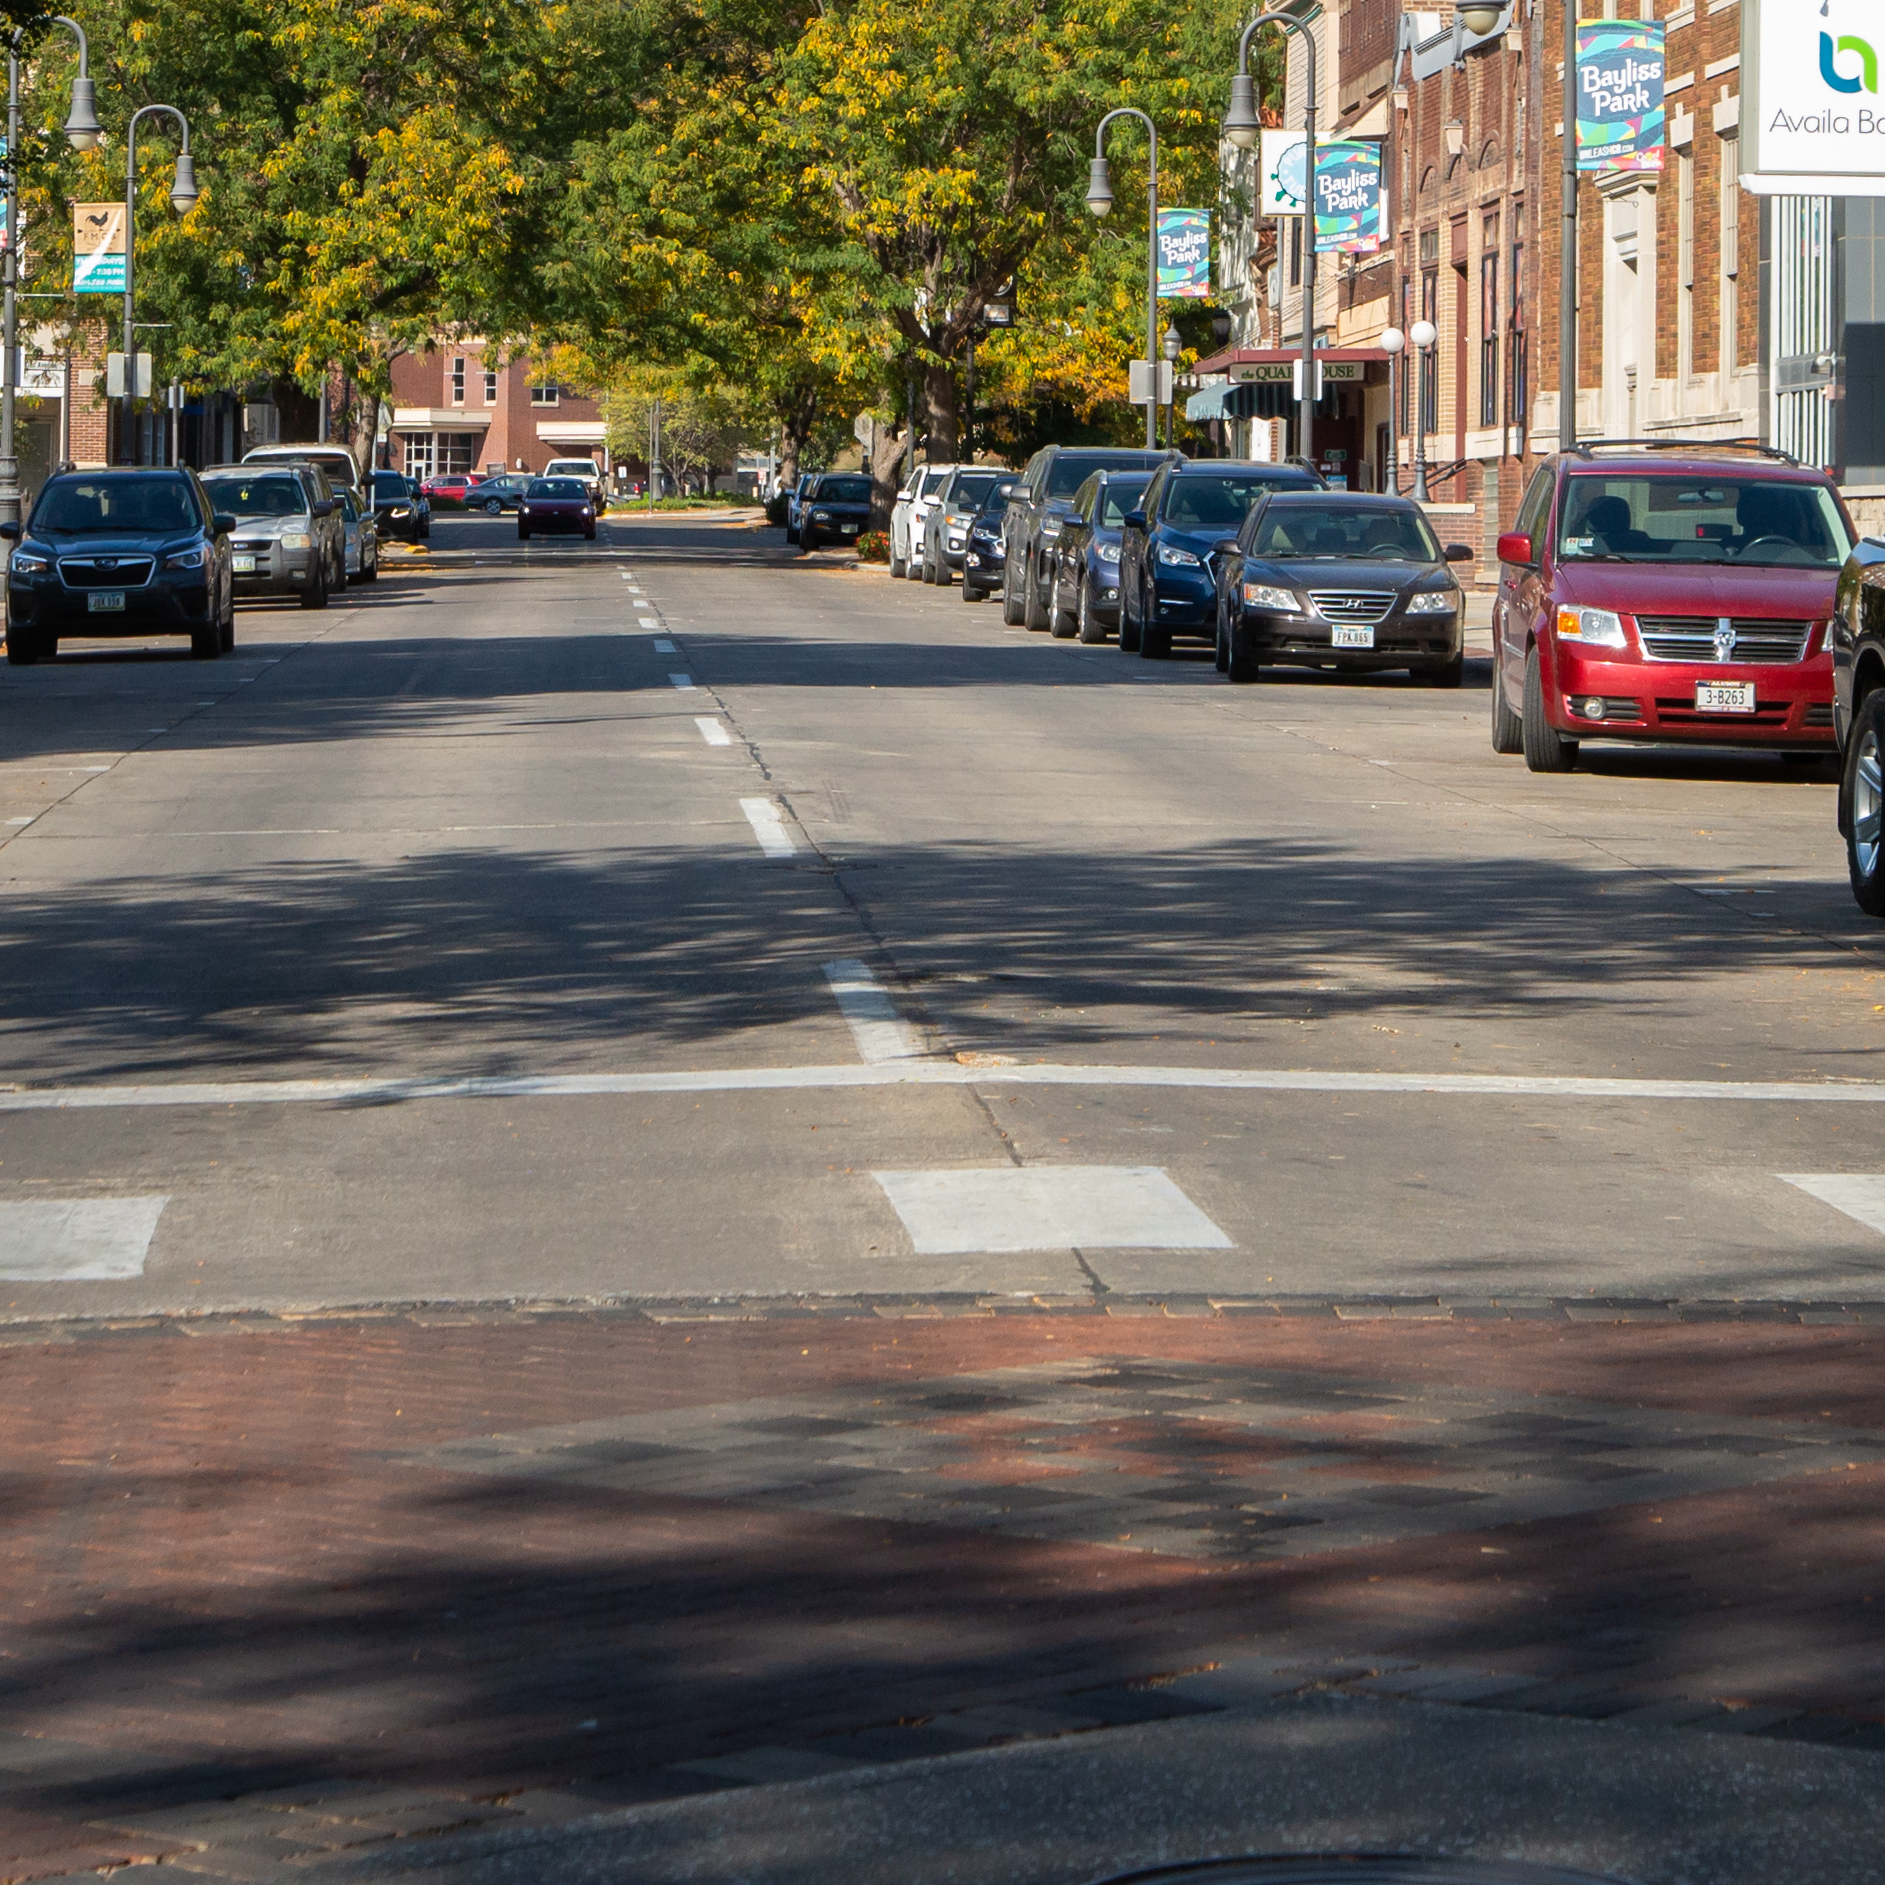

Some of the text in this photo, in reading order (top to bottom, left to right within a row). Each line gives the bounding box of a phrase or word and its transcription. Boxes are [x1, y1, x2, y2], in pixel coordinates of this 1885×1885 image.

[1580, 57, 1662, 94] Bayliss
[1591, 82, 1650, 117] Park
[1769, 107, 1849, 134] Availa
[1317, 168, 1377, 197] Bayliss
[1325, 187, 1369, 214] Park
[1159, 229, 1207, 252] Bayliss
[1166, 245, 1201, 266] Park
[1706, 689, 1745, 705] 3-B263
